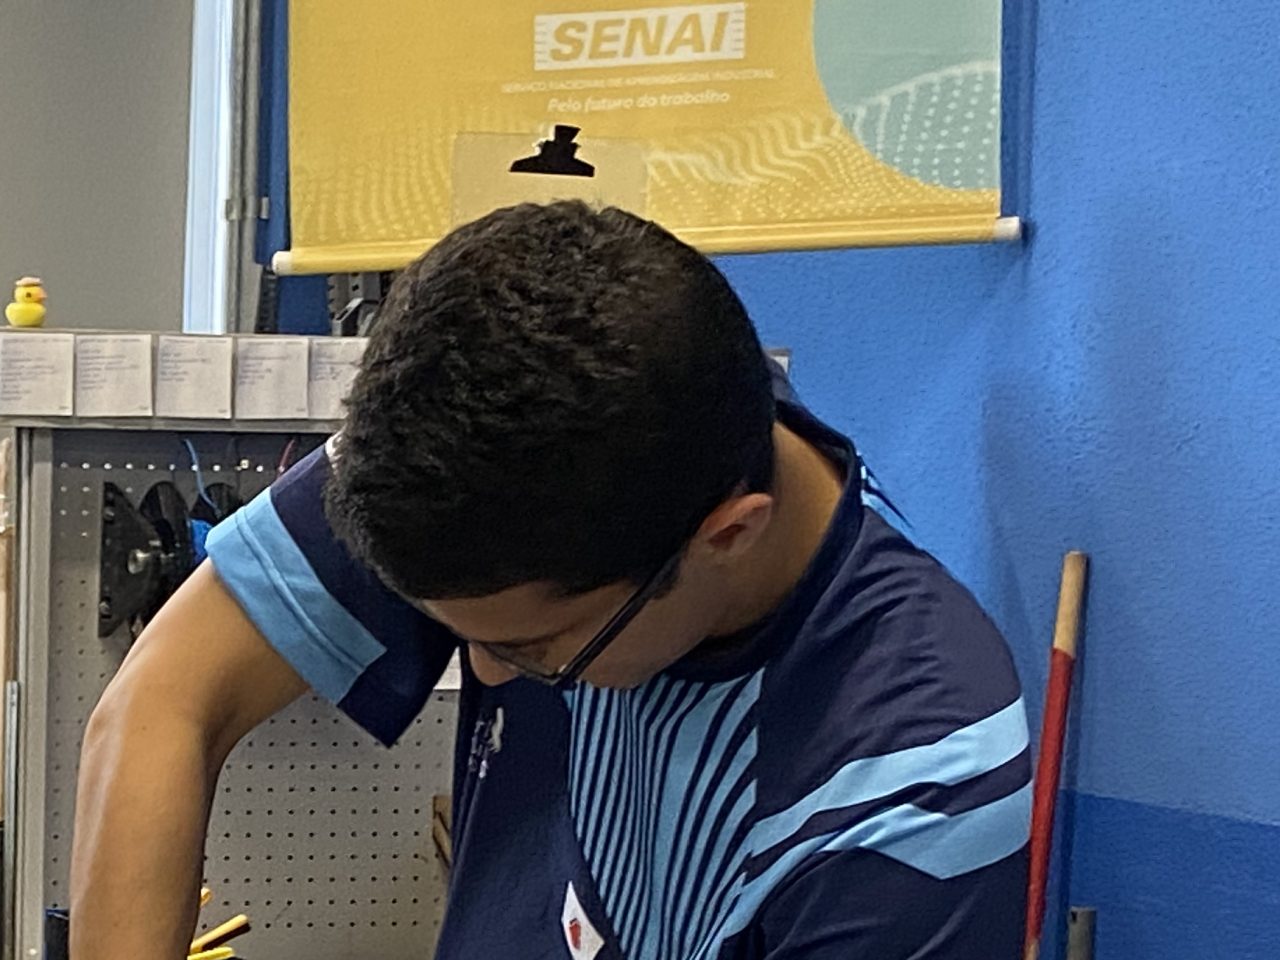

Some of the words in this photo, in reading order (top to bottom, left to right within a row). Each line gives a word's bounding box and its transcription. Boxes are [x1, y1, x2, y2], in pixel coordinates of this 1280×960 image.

[549, 11, 731, 62] SENAI
[546, 96, 582, 113] Pelo
[584, 95, 634, 113] futuro
[636, 92, 658, 108] do
[660, 88, 731, 106] trabalho
